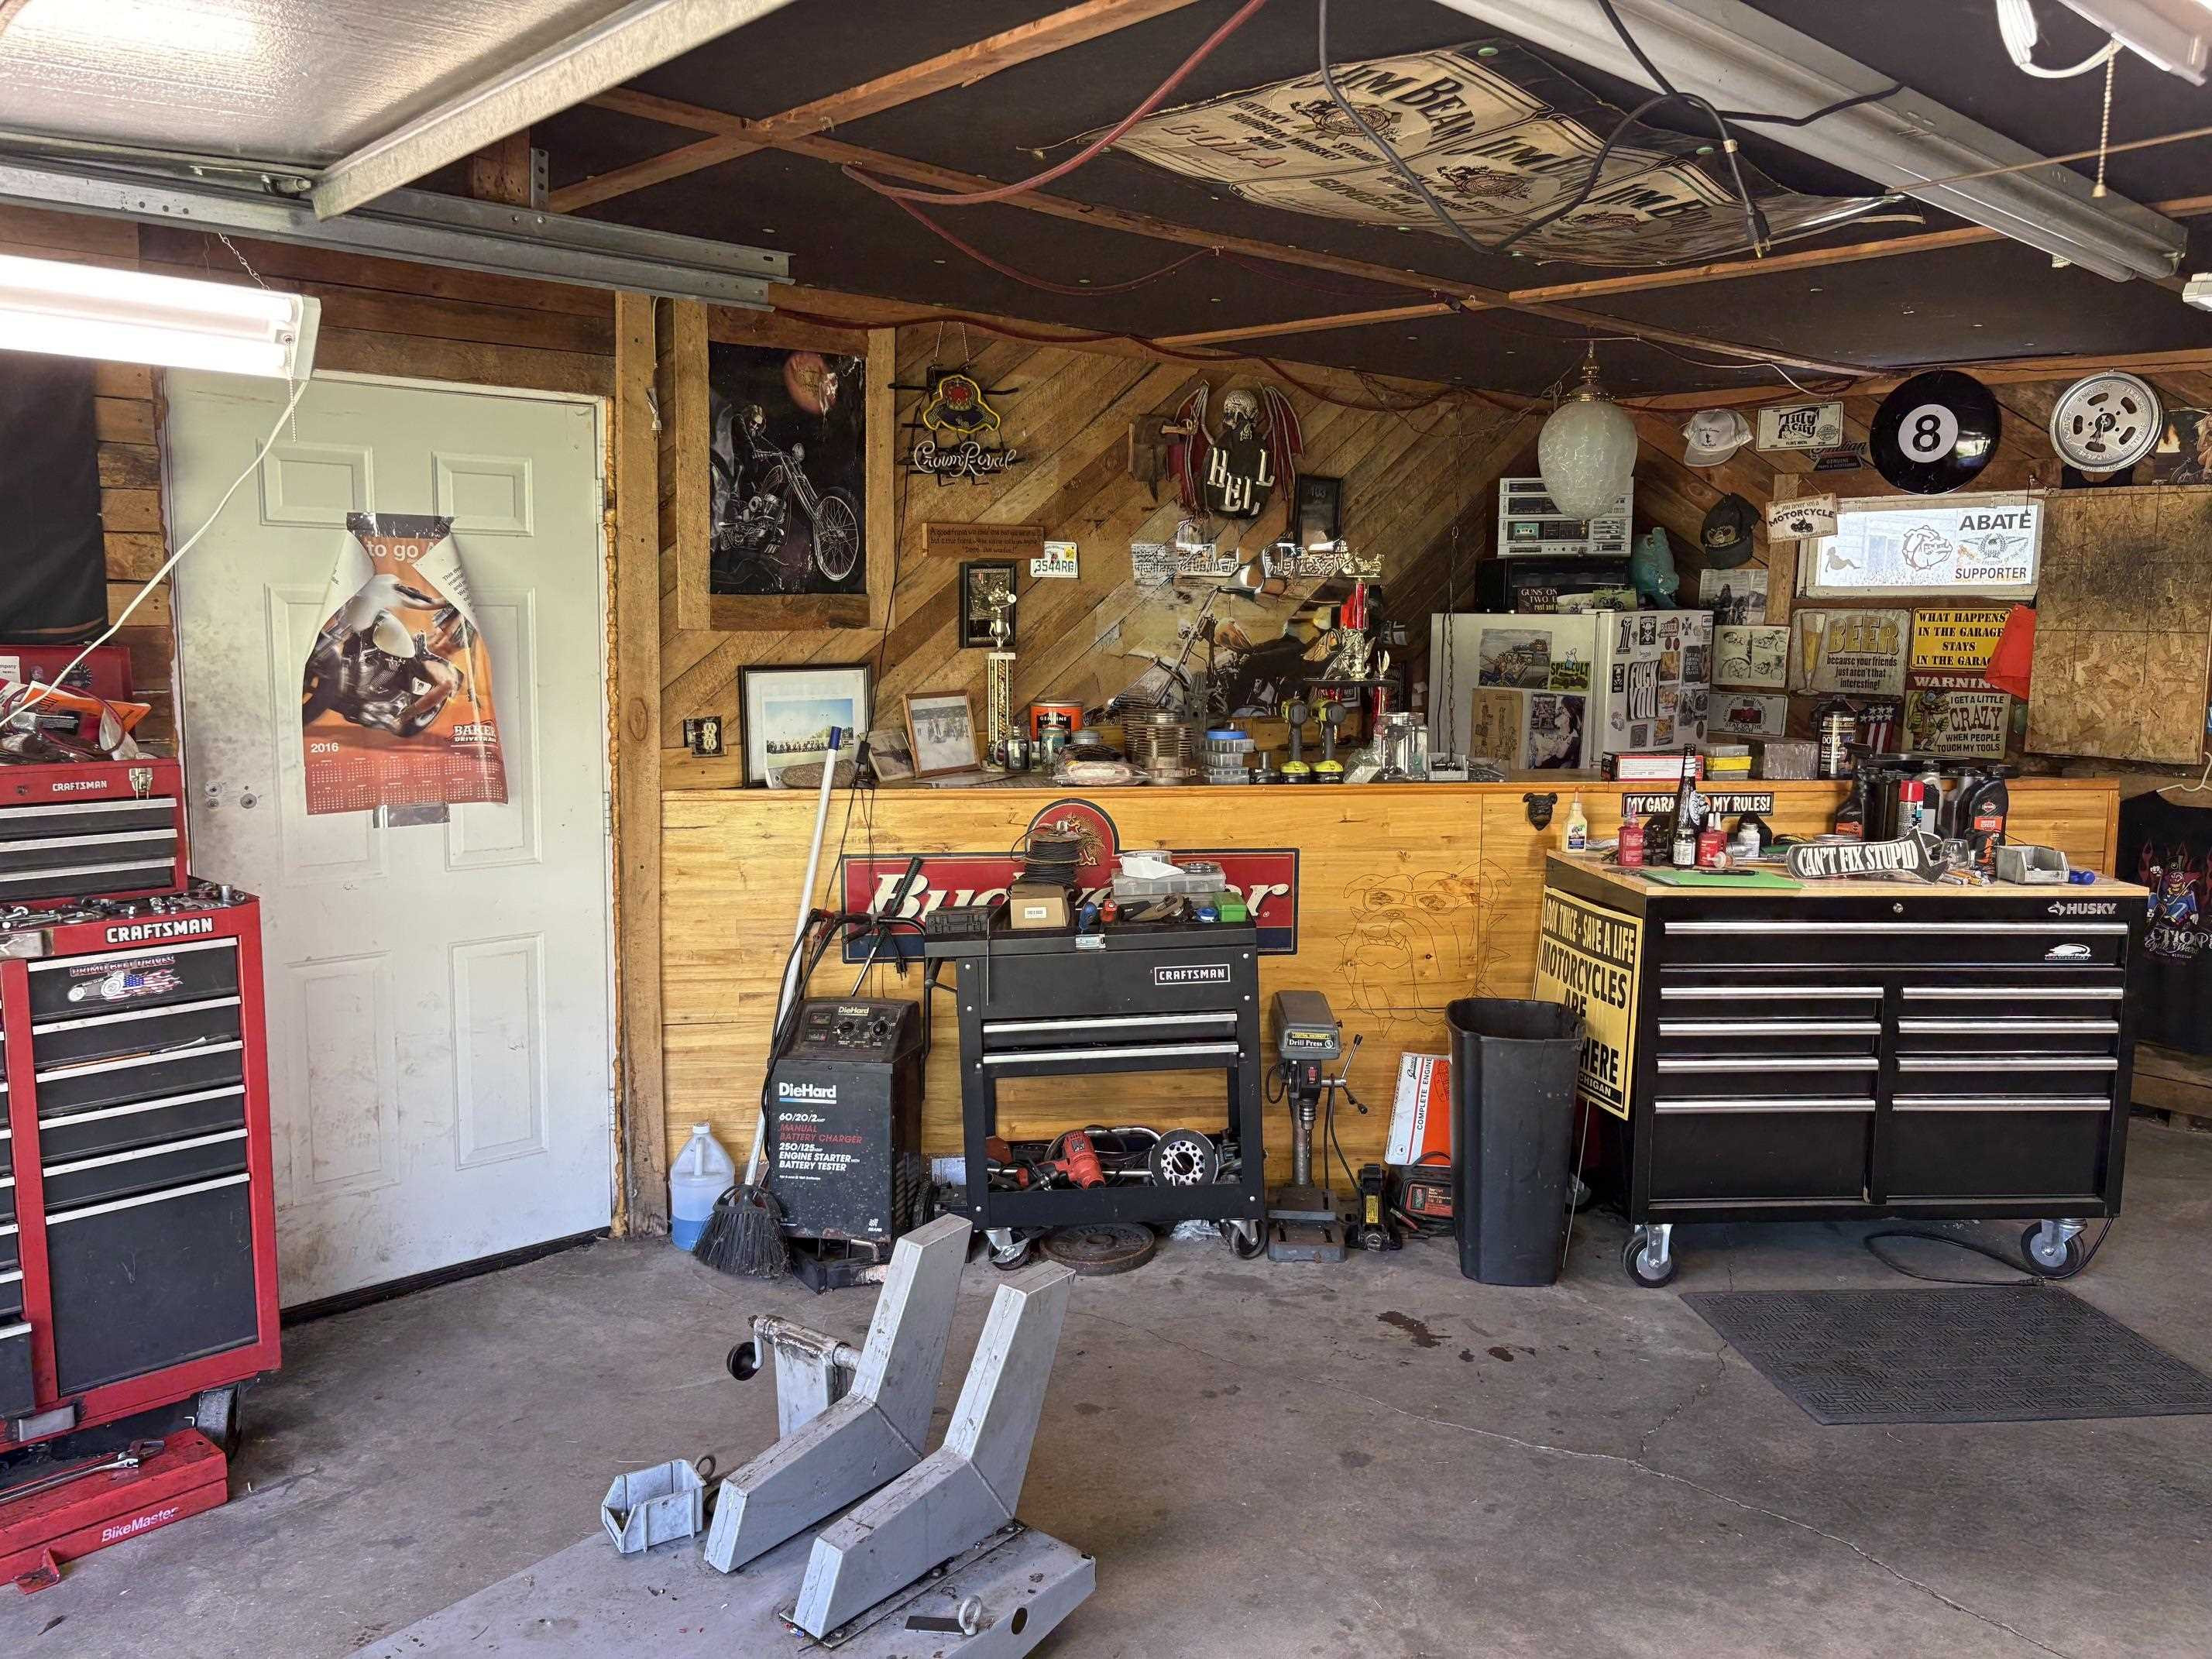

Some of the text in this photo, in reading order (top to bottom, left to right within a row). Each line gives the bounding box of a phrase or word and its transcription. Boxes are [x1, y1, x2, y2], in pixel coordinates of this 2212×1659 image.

[1913, 414, 1941, 452] 8
[914, 440, 1017, 477] Crown Royal
[1768, 508, 1835, 527] MOTORCYCLE
[1959, 514, 2031, 531] ABATE
[366, 541, 418, 561] to go
[1955, 567, 2027, 579] SUPPORTER
[1919, 613, 2006, 623] WHAT HAPPENS
[1828, 615, 1899, 655] BEER
[1918, 627, 2004, 637] IN THE GARAGE
[1942, 641, 1977, 651] STAYS
[1827, 655, 1898, 666] because your friends
[1916, 655, 1992, 666] IN THE GARA
[1630, 661, 1659, 689] FUCK
[1836, 667, 1849, 678] just
[1871, 668, 1887, 678] that
[1914, 676, 2002, 689] WARNIN
[1630, 686, 1657, 720] YOU
[1977, 696, 2004, 704] LITTLE
[1949, 705, 2003, 732] CRAZY
[454, 724, 496, 737] BAKER
[1946, 733, 1969, 742] WHEN
[311, 743, 339, 753] 2016
[52, 780, 108, 791] CRAFTSMAN
[1626, 796, 1644, 812] MY
[1647, 796, 1674, 813] GARA
[1713, 796, 1729, 812] MY
[1733, 796, 1771, 812] RULES!
[1797, 840, 1919, 877] CAN'T FIX STUPID
[2066, 902, 2117, 915] HUSKY
[106, 917, 213, 943] CRAFTSMAN
[1543, 897, 1635, 964] LOOK TWICE SAVE A LIFE
[1159, 967, 1225, 982] CRAFTSMAN
[1540, 939, 1627, 1009] MOTORCYCLES
[779, 1082, 836, 1098] DieHard
[1417, 1057, 1432, 1130] COMPLETE ENGINE
[778, 1112, 818, 1122] 60/20/2
[780, 1123, 818, 1132] MANUAL
[780, 1132, 863, 1144] BATTERY CHARGER
[779, 1151, 812, 1161] ENGINE
[814, 1152, 852, 1163] STARTER
[778, 1160, 847, 1171] BATTERY TESTER
[101, 1506, 179, 1543] BikeMaster
